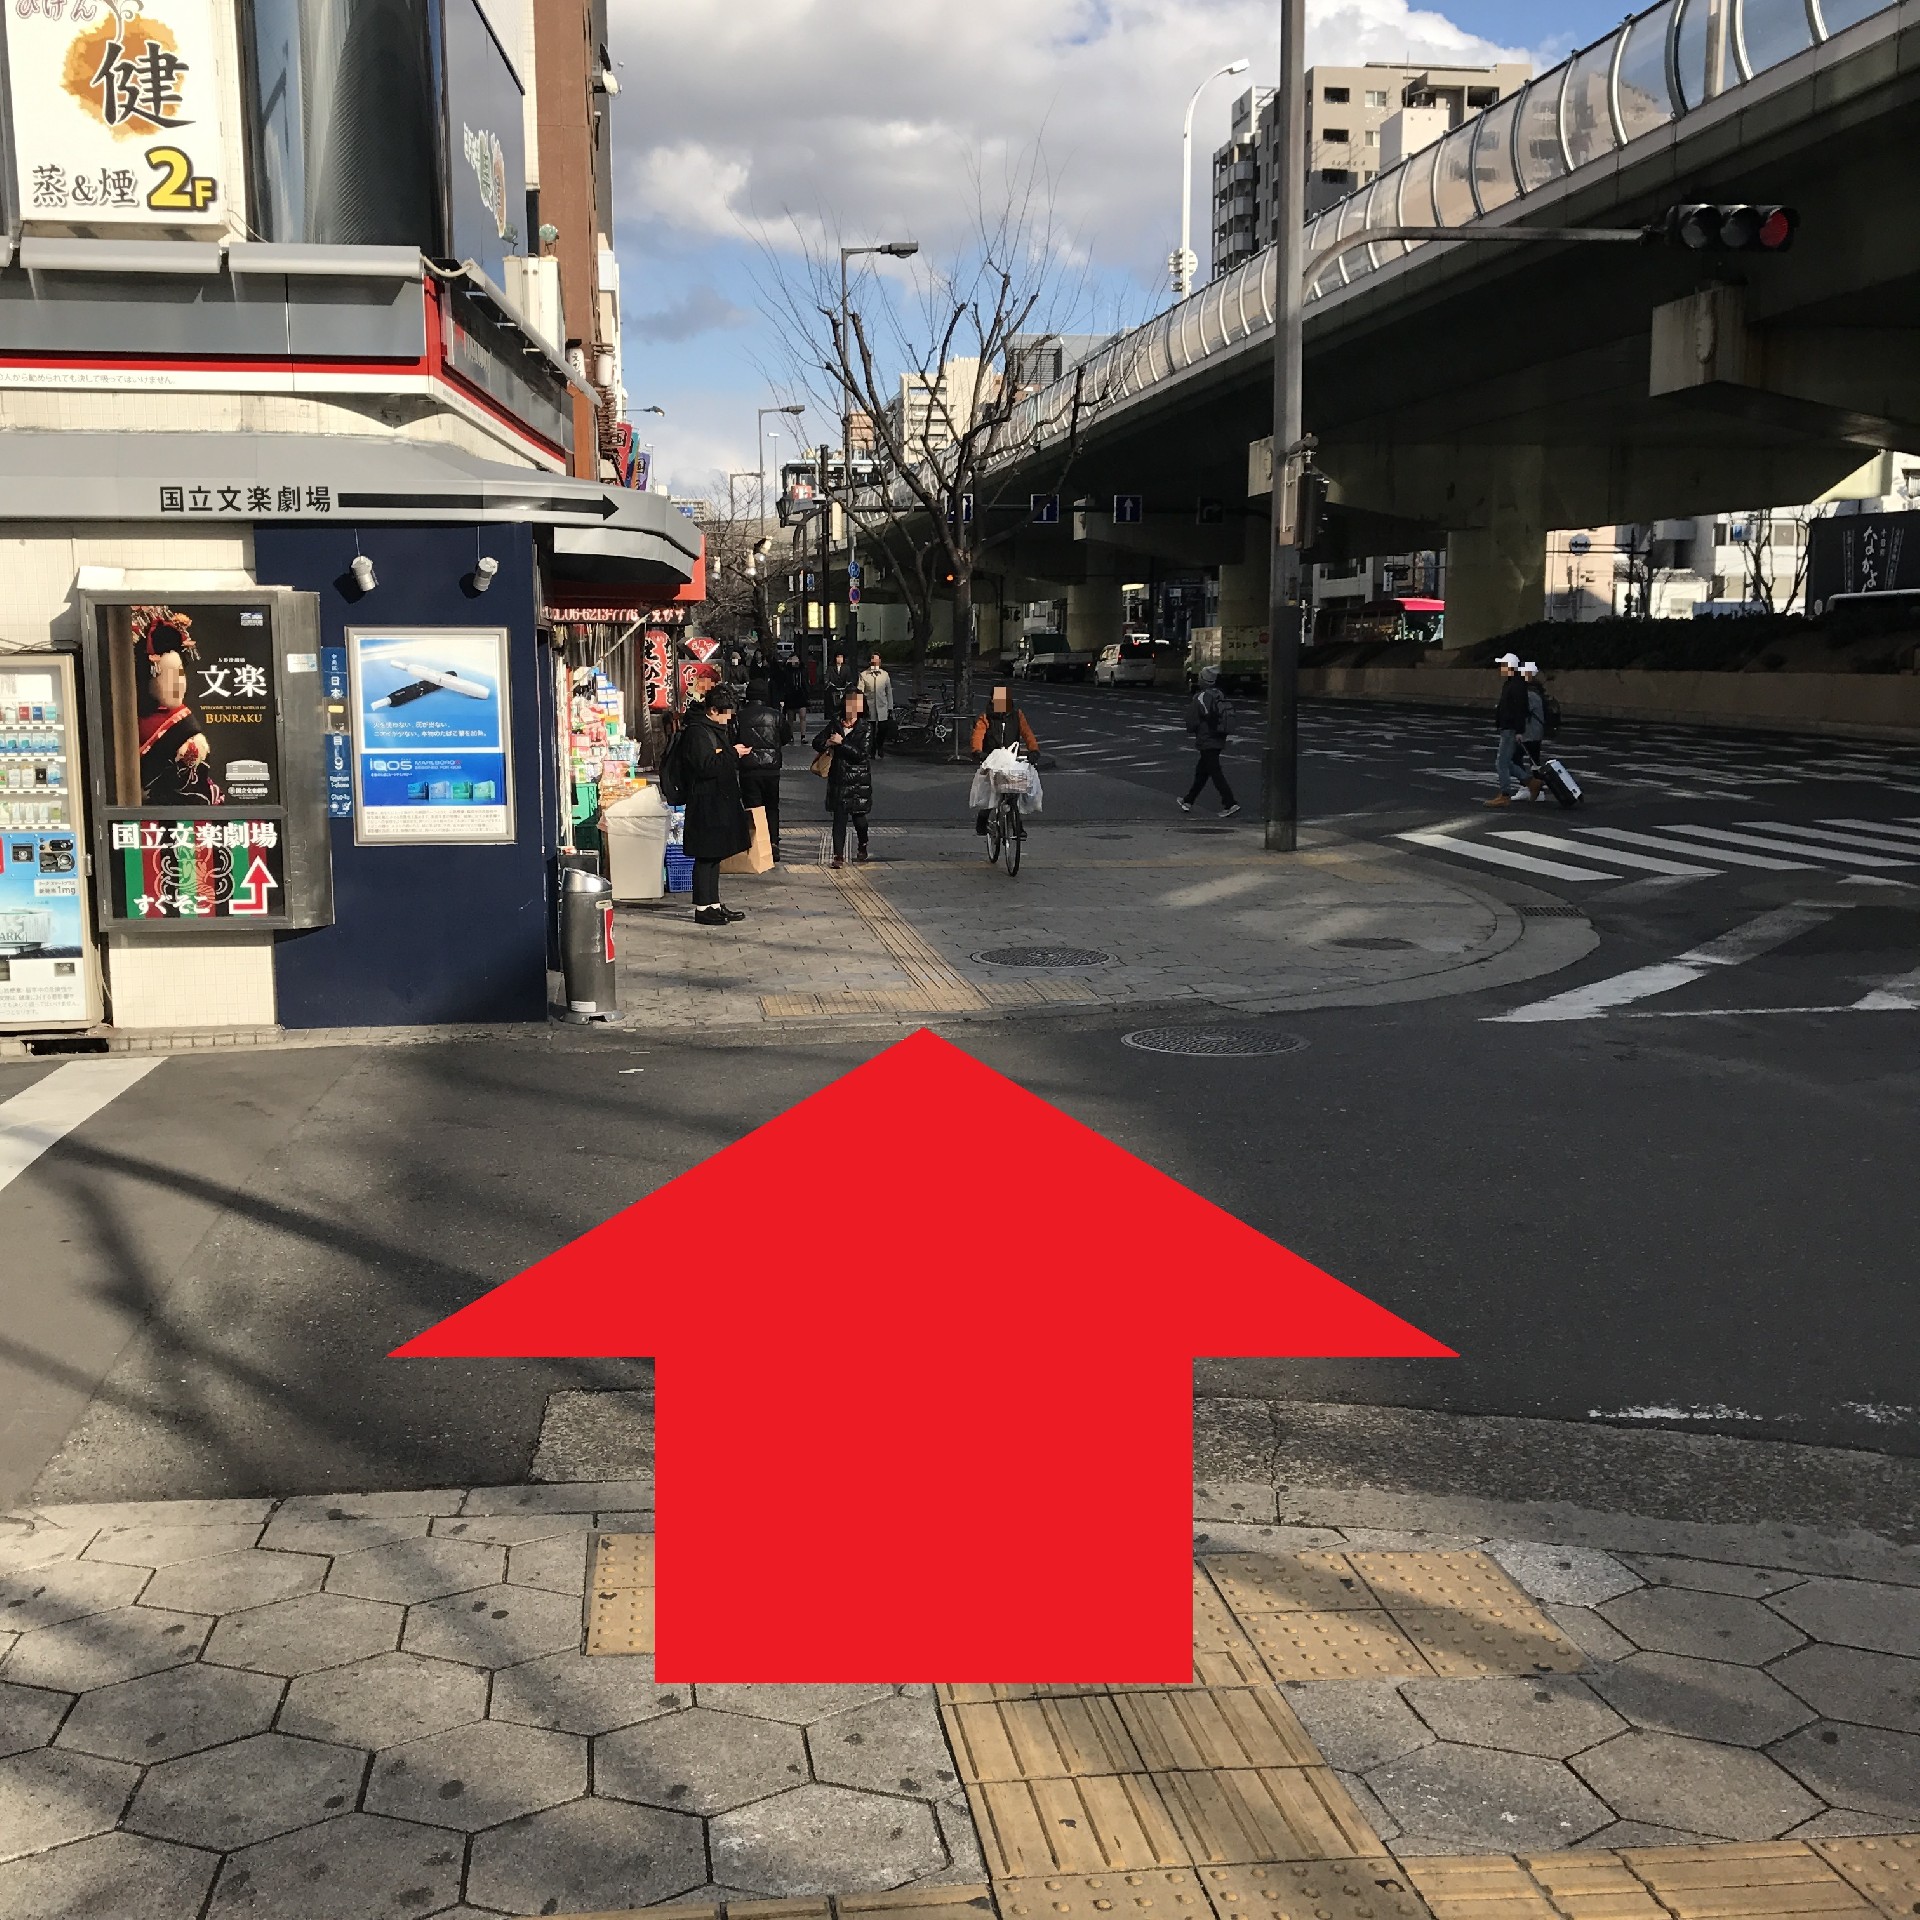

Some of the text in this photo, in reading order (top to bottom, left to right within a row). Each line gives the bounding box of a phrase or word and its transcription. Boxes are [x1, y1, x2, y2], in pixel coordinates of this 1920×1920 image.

[90, 42, 196, 129] 健
[33, 164, 137, 206] 蒸&煙
[145, 146, 217, 211] 2F
[159, 485, 331, 512] 国立文楽劇場
[196, 664, 268, 698] 文楽
[206, 713, 263, 724] BUNRAKU
[112, 823, 278, 850] 国立文楽劇場
[134, 894, 210, 915] すぐそこ
